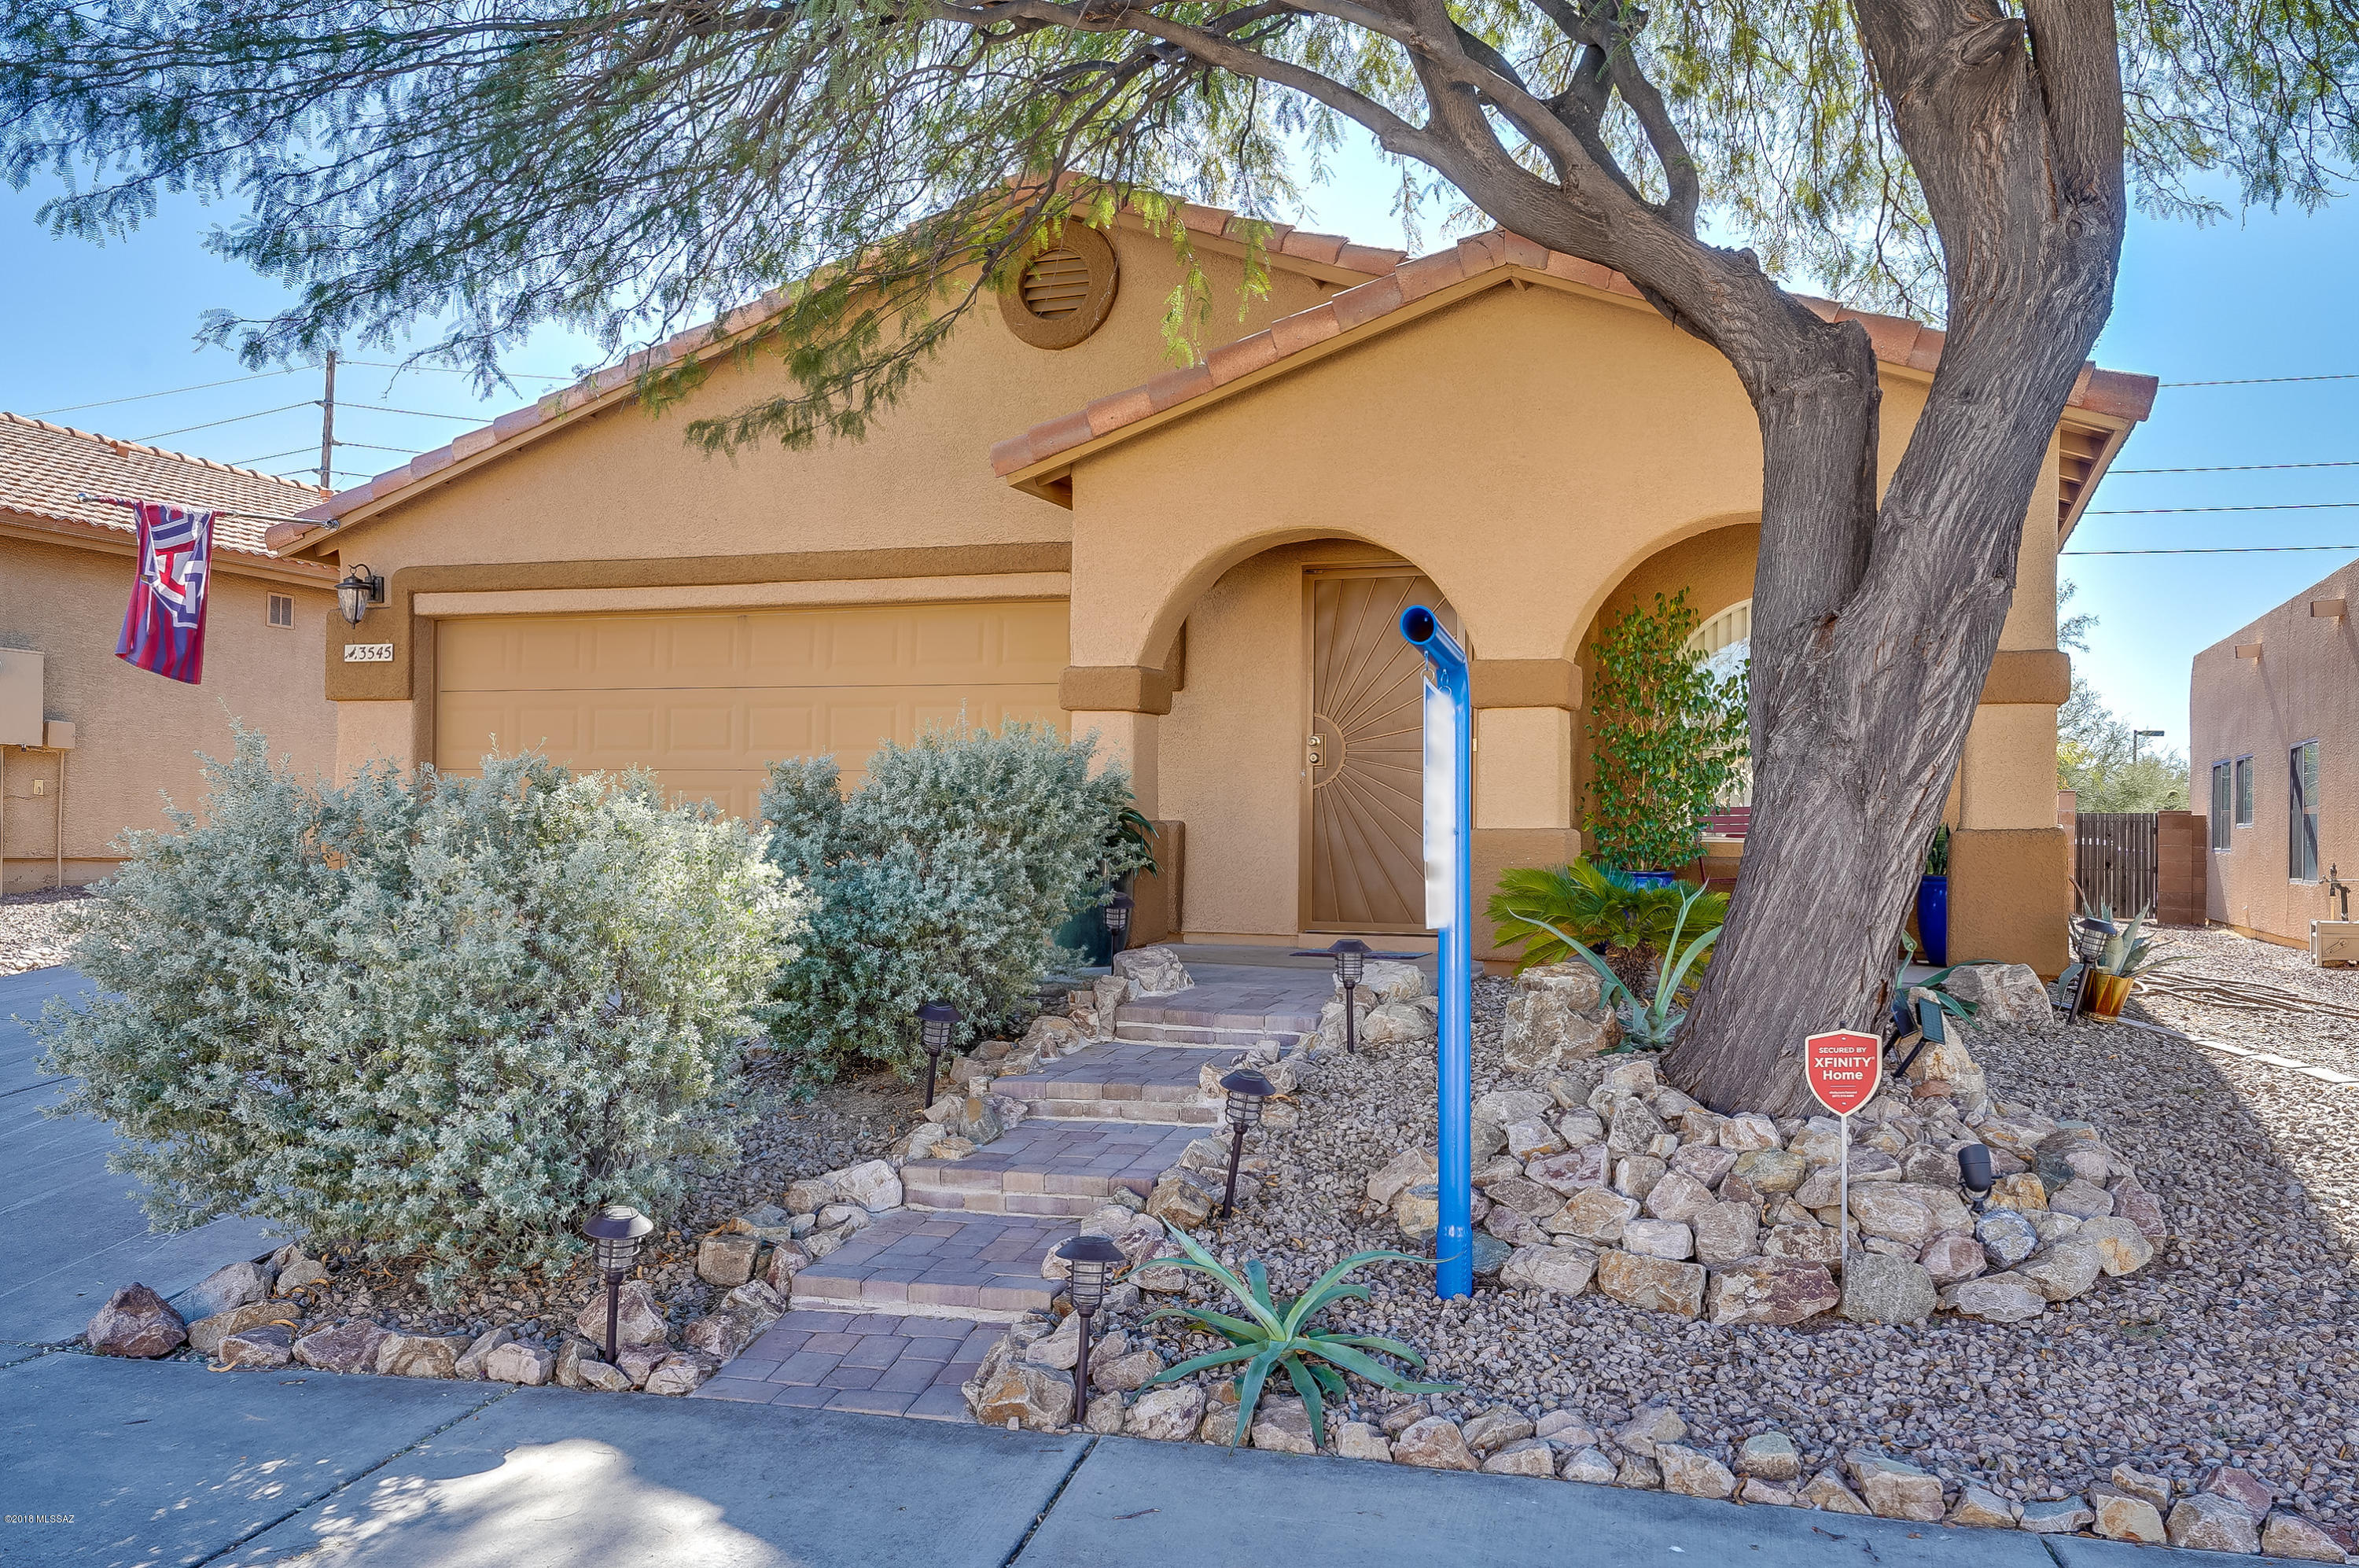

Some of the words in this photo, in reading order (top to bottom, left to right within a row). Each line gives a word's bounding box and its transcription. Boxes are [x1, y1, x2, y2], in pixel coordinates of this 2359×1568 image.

[359, 646, 392, 660] 3545
[1813, 1057, 1871, 1068] XFINITY
[1823, 1069, 1864, 1080] Home
